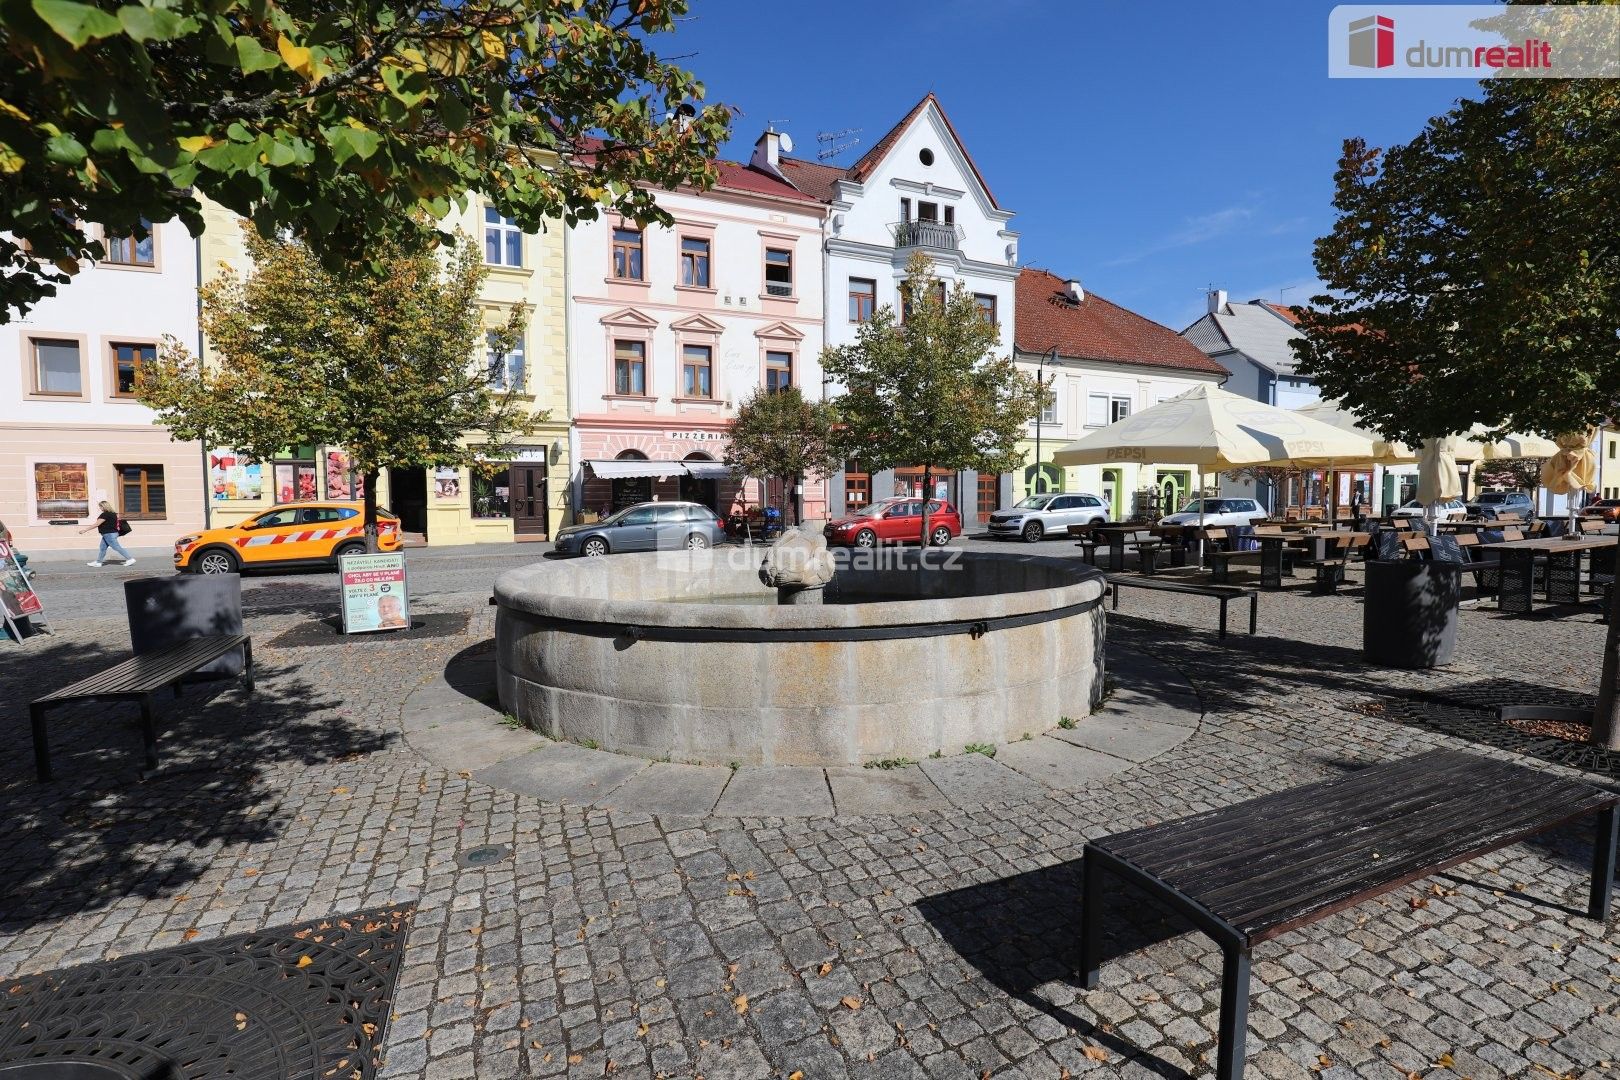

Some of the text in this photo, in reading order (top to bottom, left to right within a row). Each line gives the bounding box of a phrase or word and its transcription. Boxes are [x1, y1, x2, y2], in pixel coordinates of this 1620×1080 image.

[672, 432, 725, 440] PIZZERIA
[1287, 440, 1325, 455] PEPSI
[1107, 448, 1146, 459] PEPSI
